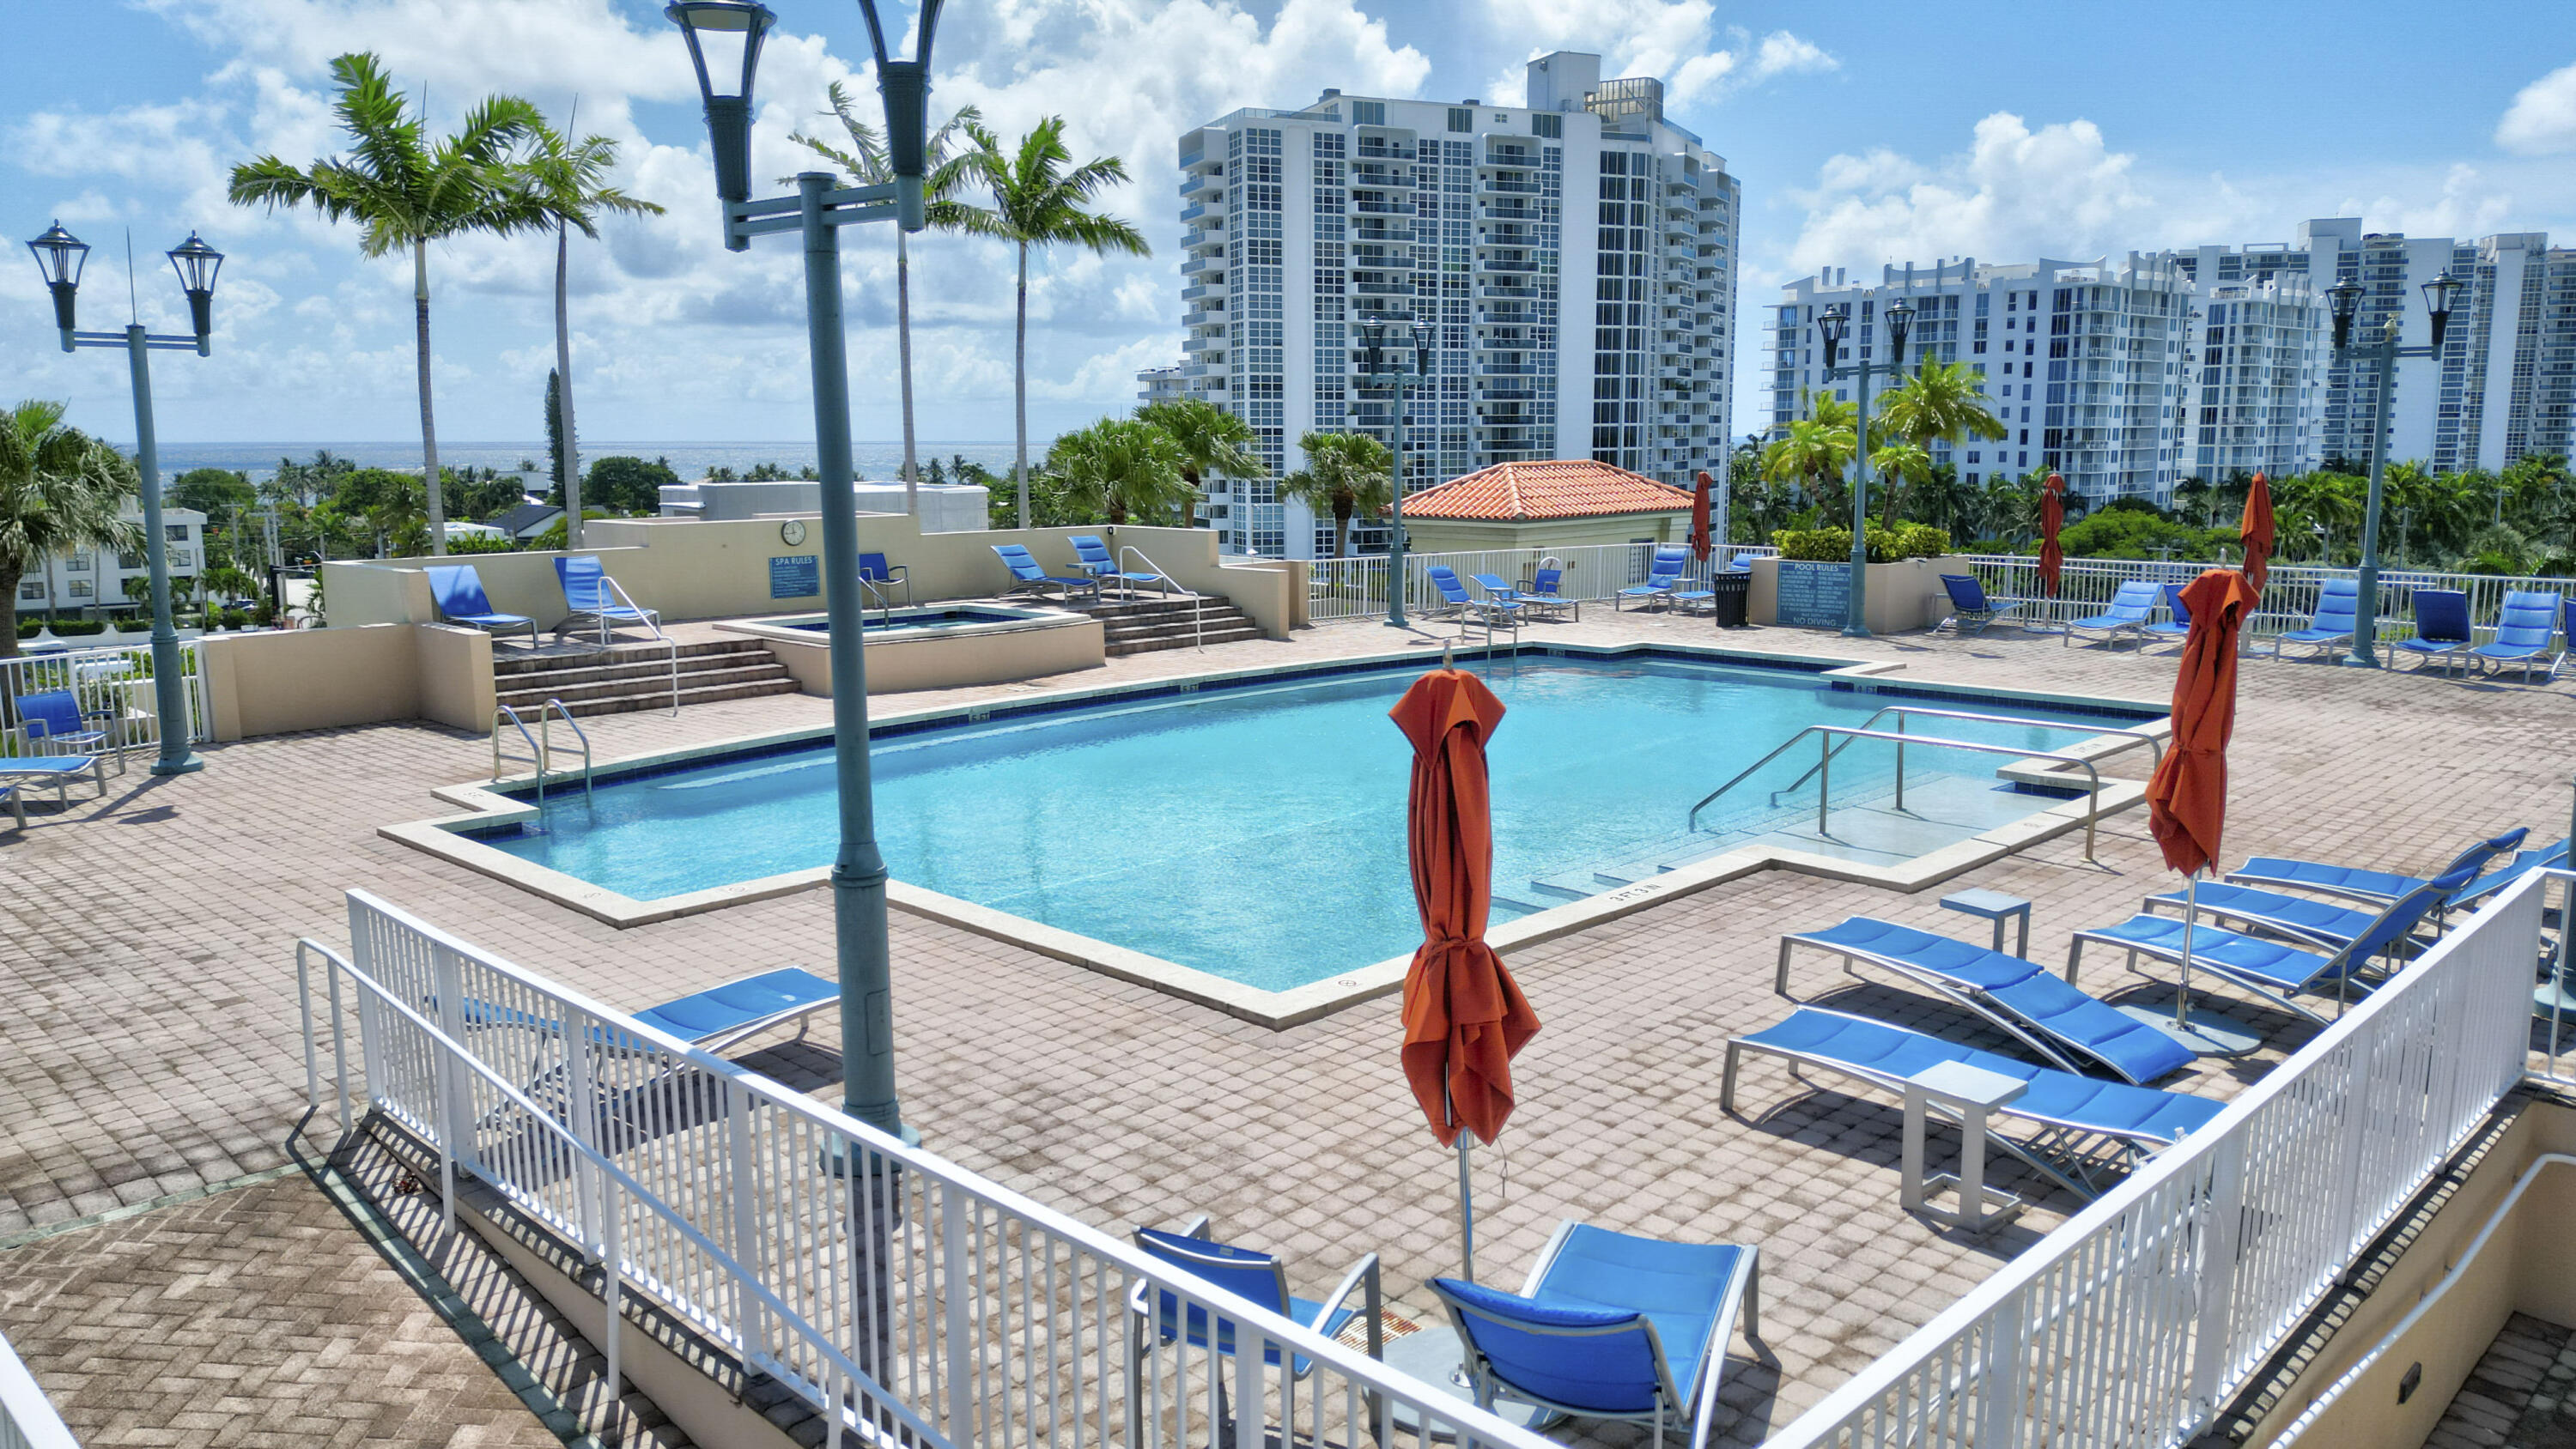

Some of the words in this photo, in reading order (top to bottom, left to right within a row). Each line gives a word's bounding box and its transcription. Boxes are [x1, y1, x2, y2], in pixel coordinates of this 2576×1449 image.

[791, 556, 812, 565] RULES
[1793, 616, 1806, 625] NO
[1807, 617, 1837, 627] DIVING
[1866, 685, 1877, 694] FT
[980, 712, 989, 723] FT
